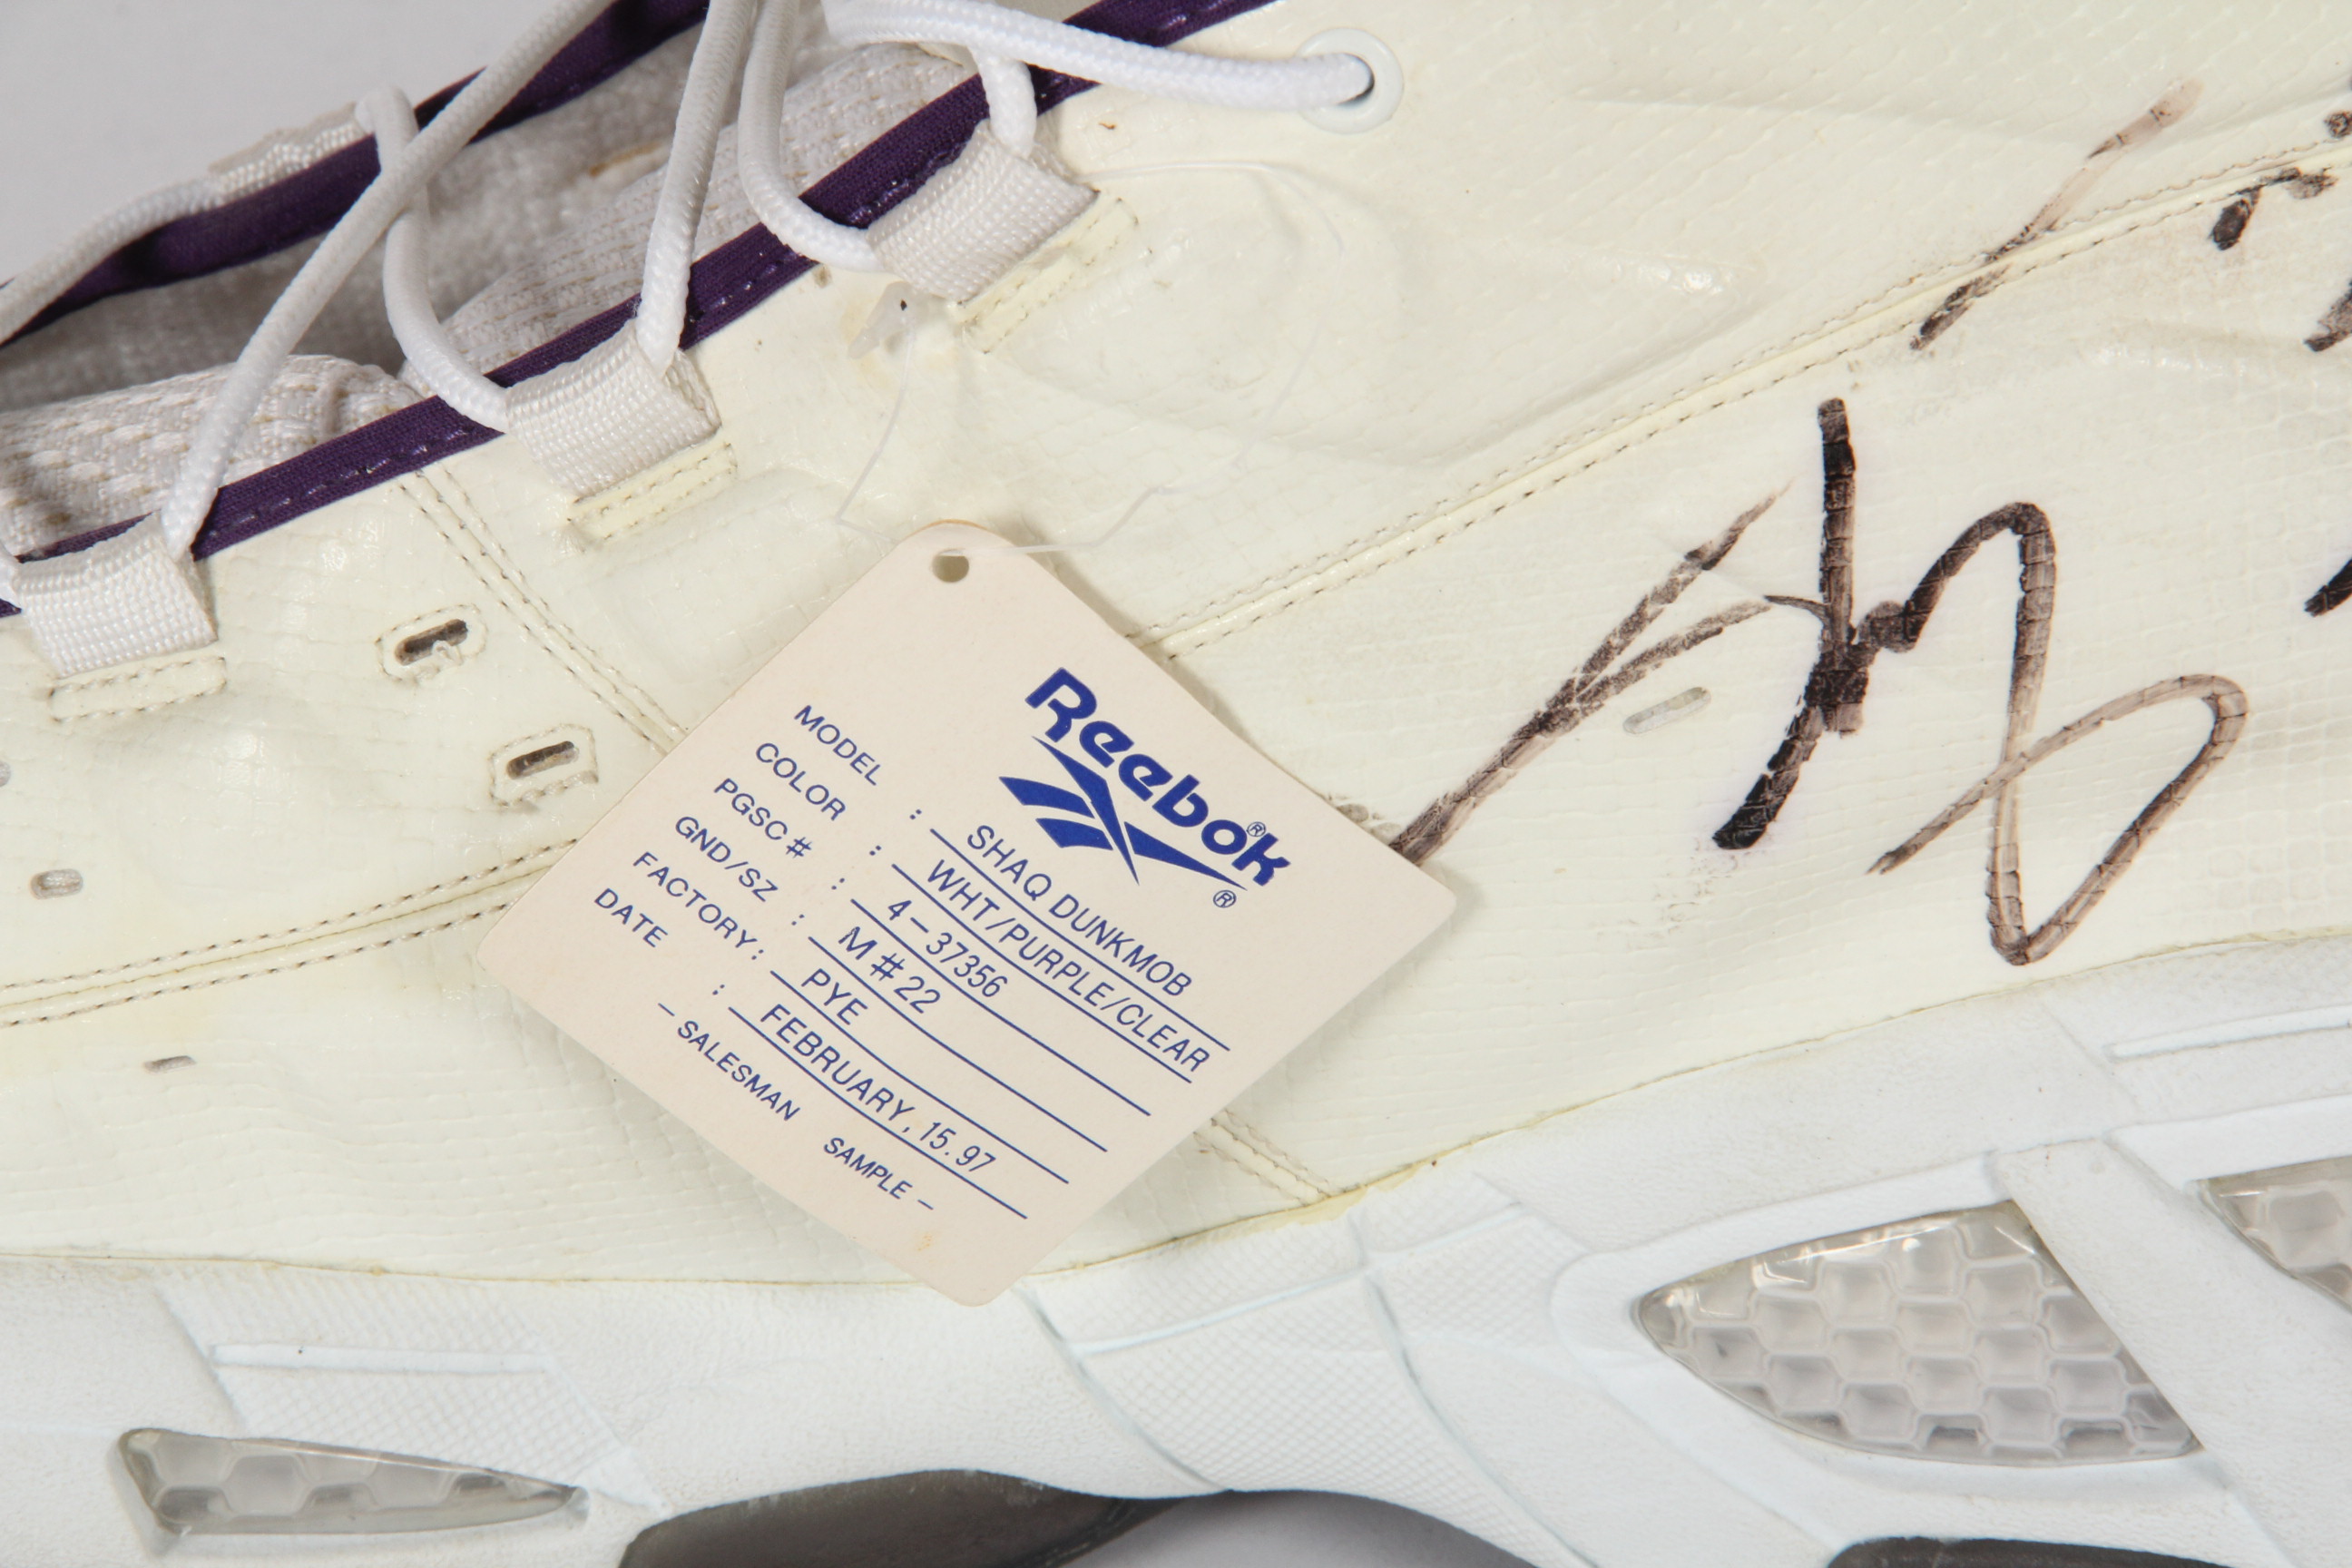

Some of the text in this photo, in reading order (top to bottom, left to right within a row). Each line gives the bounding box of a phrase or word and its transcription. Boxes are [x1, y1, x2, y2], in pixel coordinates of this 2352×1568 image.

[676, 816, 779, 902] GND/SZ
[795, 705, 882, 786] MODEL
[966, 824, 1054, 901] SHAQ
[1049, 893, 1192, 996] DUNKMOB
[1025, 667, 1290, 887] Reebok
[595, 887, 669, 948] DATE
[634, 851, 869, 1025] FACTORY: PYE
[756, 742, 848, 821] COLOR
[927, 858, 1210, 1072] WHT/PURPLE/CLEAR
[678, 1019, 802, 1120] SALESMAN
[823, 1136, 914, 1200] SAMPLE
